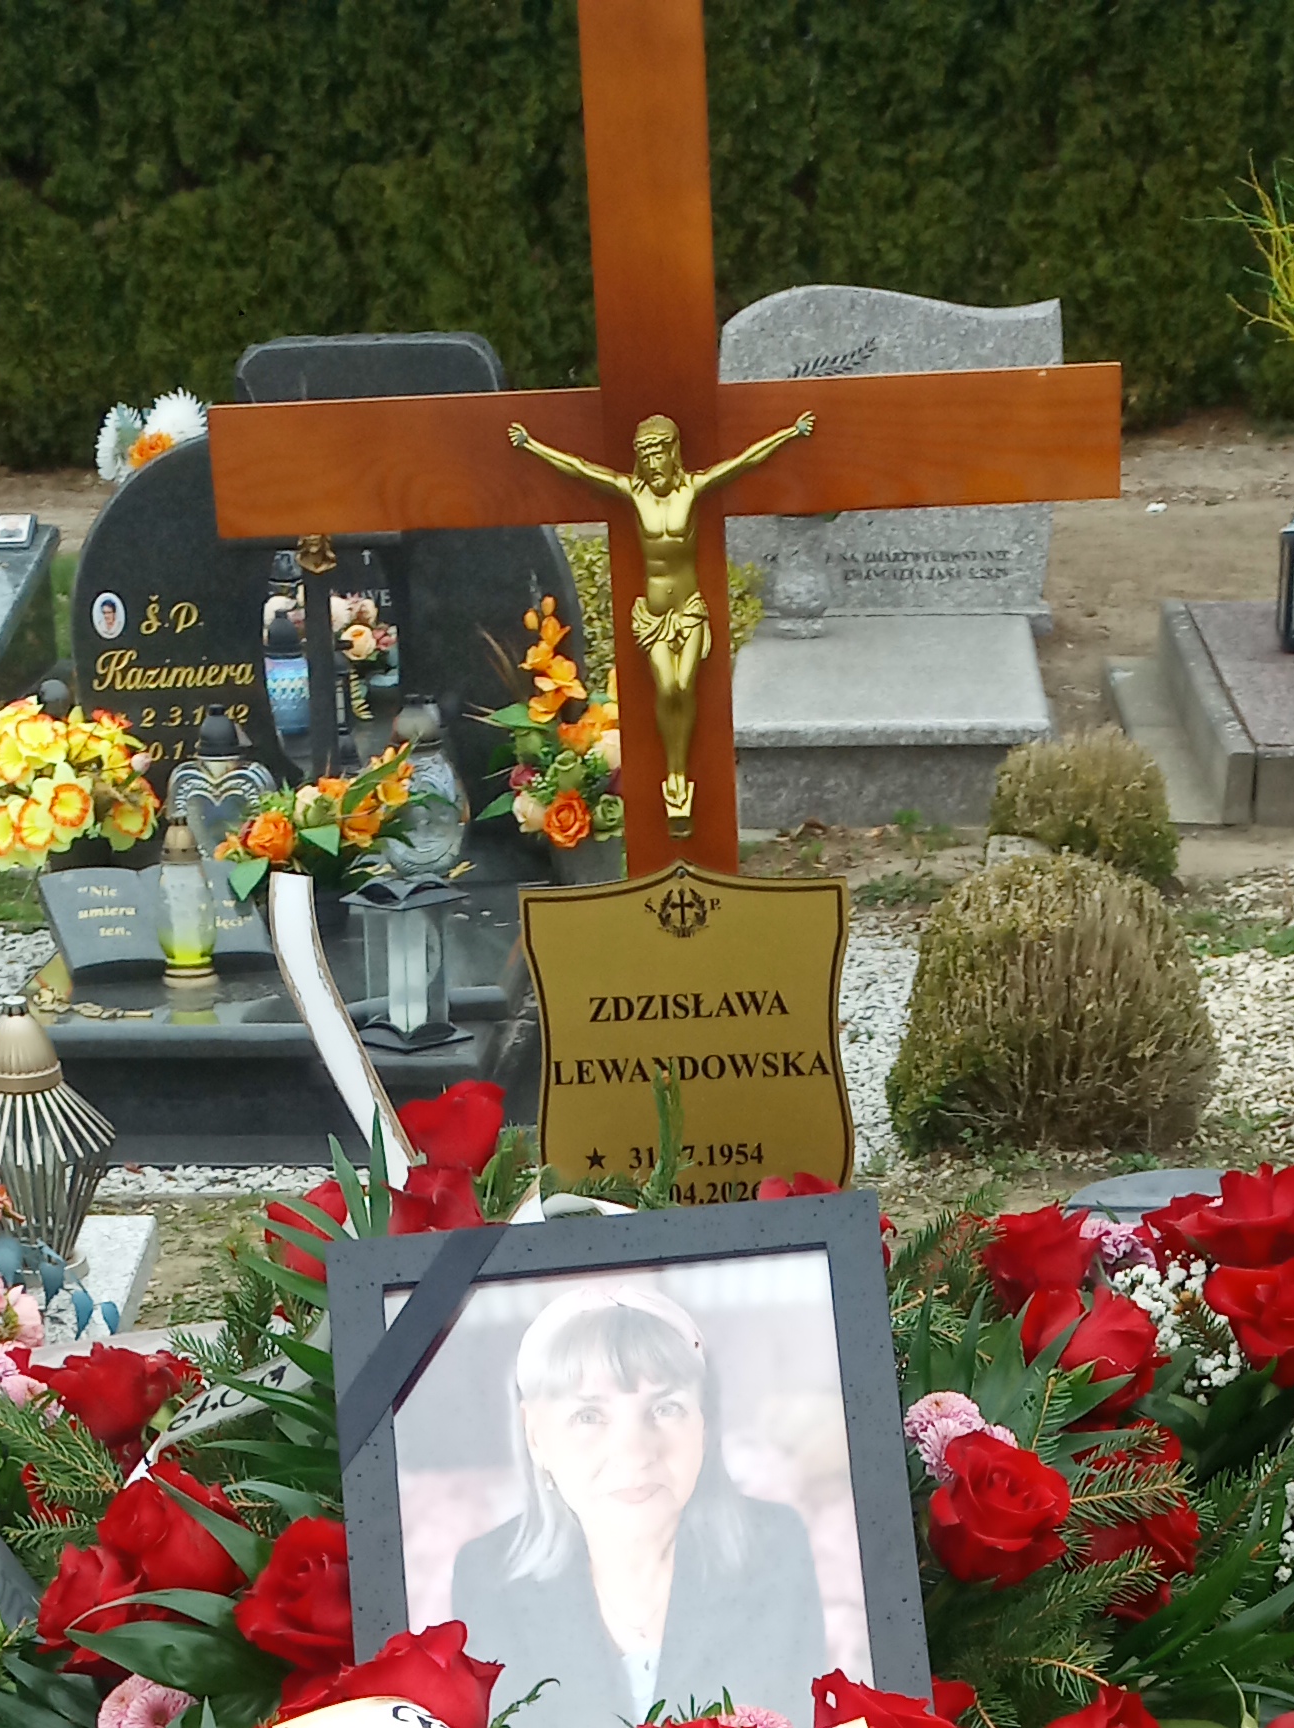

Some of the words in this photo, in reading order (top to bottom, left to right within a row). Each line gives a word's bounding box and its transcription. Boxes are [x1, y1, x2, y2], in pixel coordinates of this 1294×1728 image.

[93, 648, 254, 692] Kazimiera
[589, 990, 789, 1022] ZDZISŁAWA
[628, 1143, 764, 1168] 317.1954
